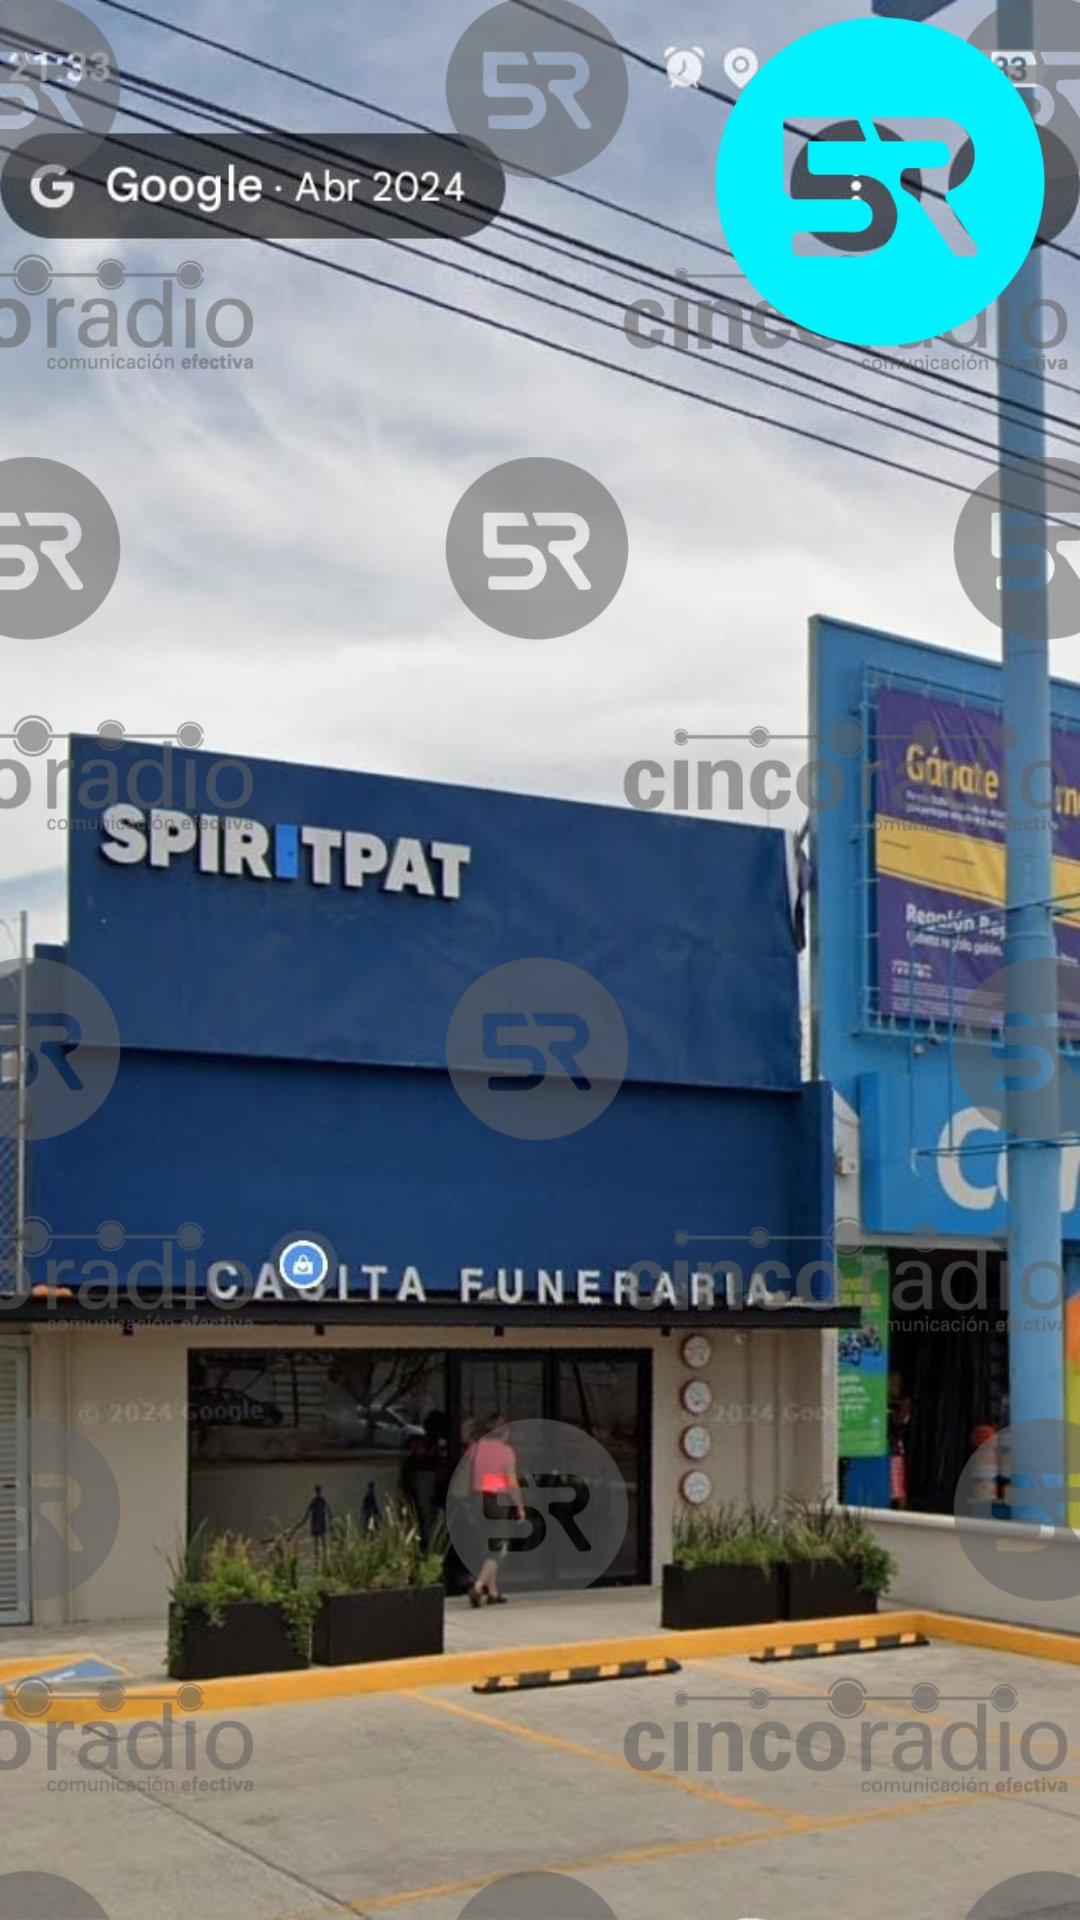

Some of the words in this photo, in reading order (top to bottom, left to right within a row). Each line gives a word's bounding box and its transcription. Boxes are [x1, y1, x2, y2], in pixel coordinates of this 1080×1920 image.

[99, 803, 472, 898] SPIRITPAT
[207, 1262, 427, 1303] CAITA
[460, 1268, 770, 1307] FUNERARIA
